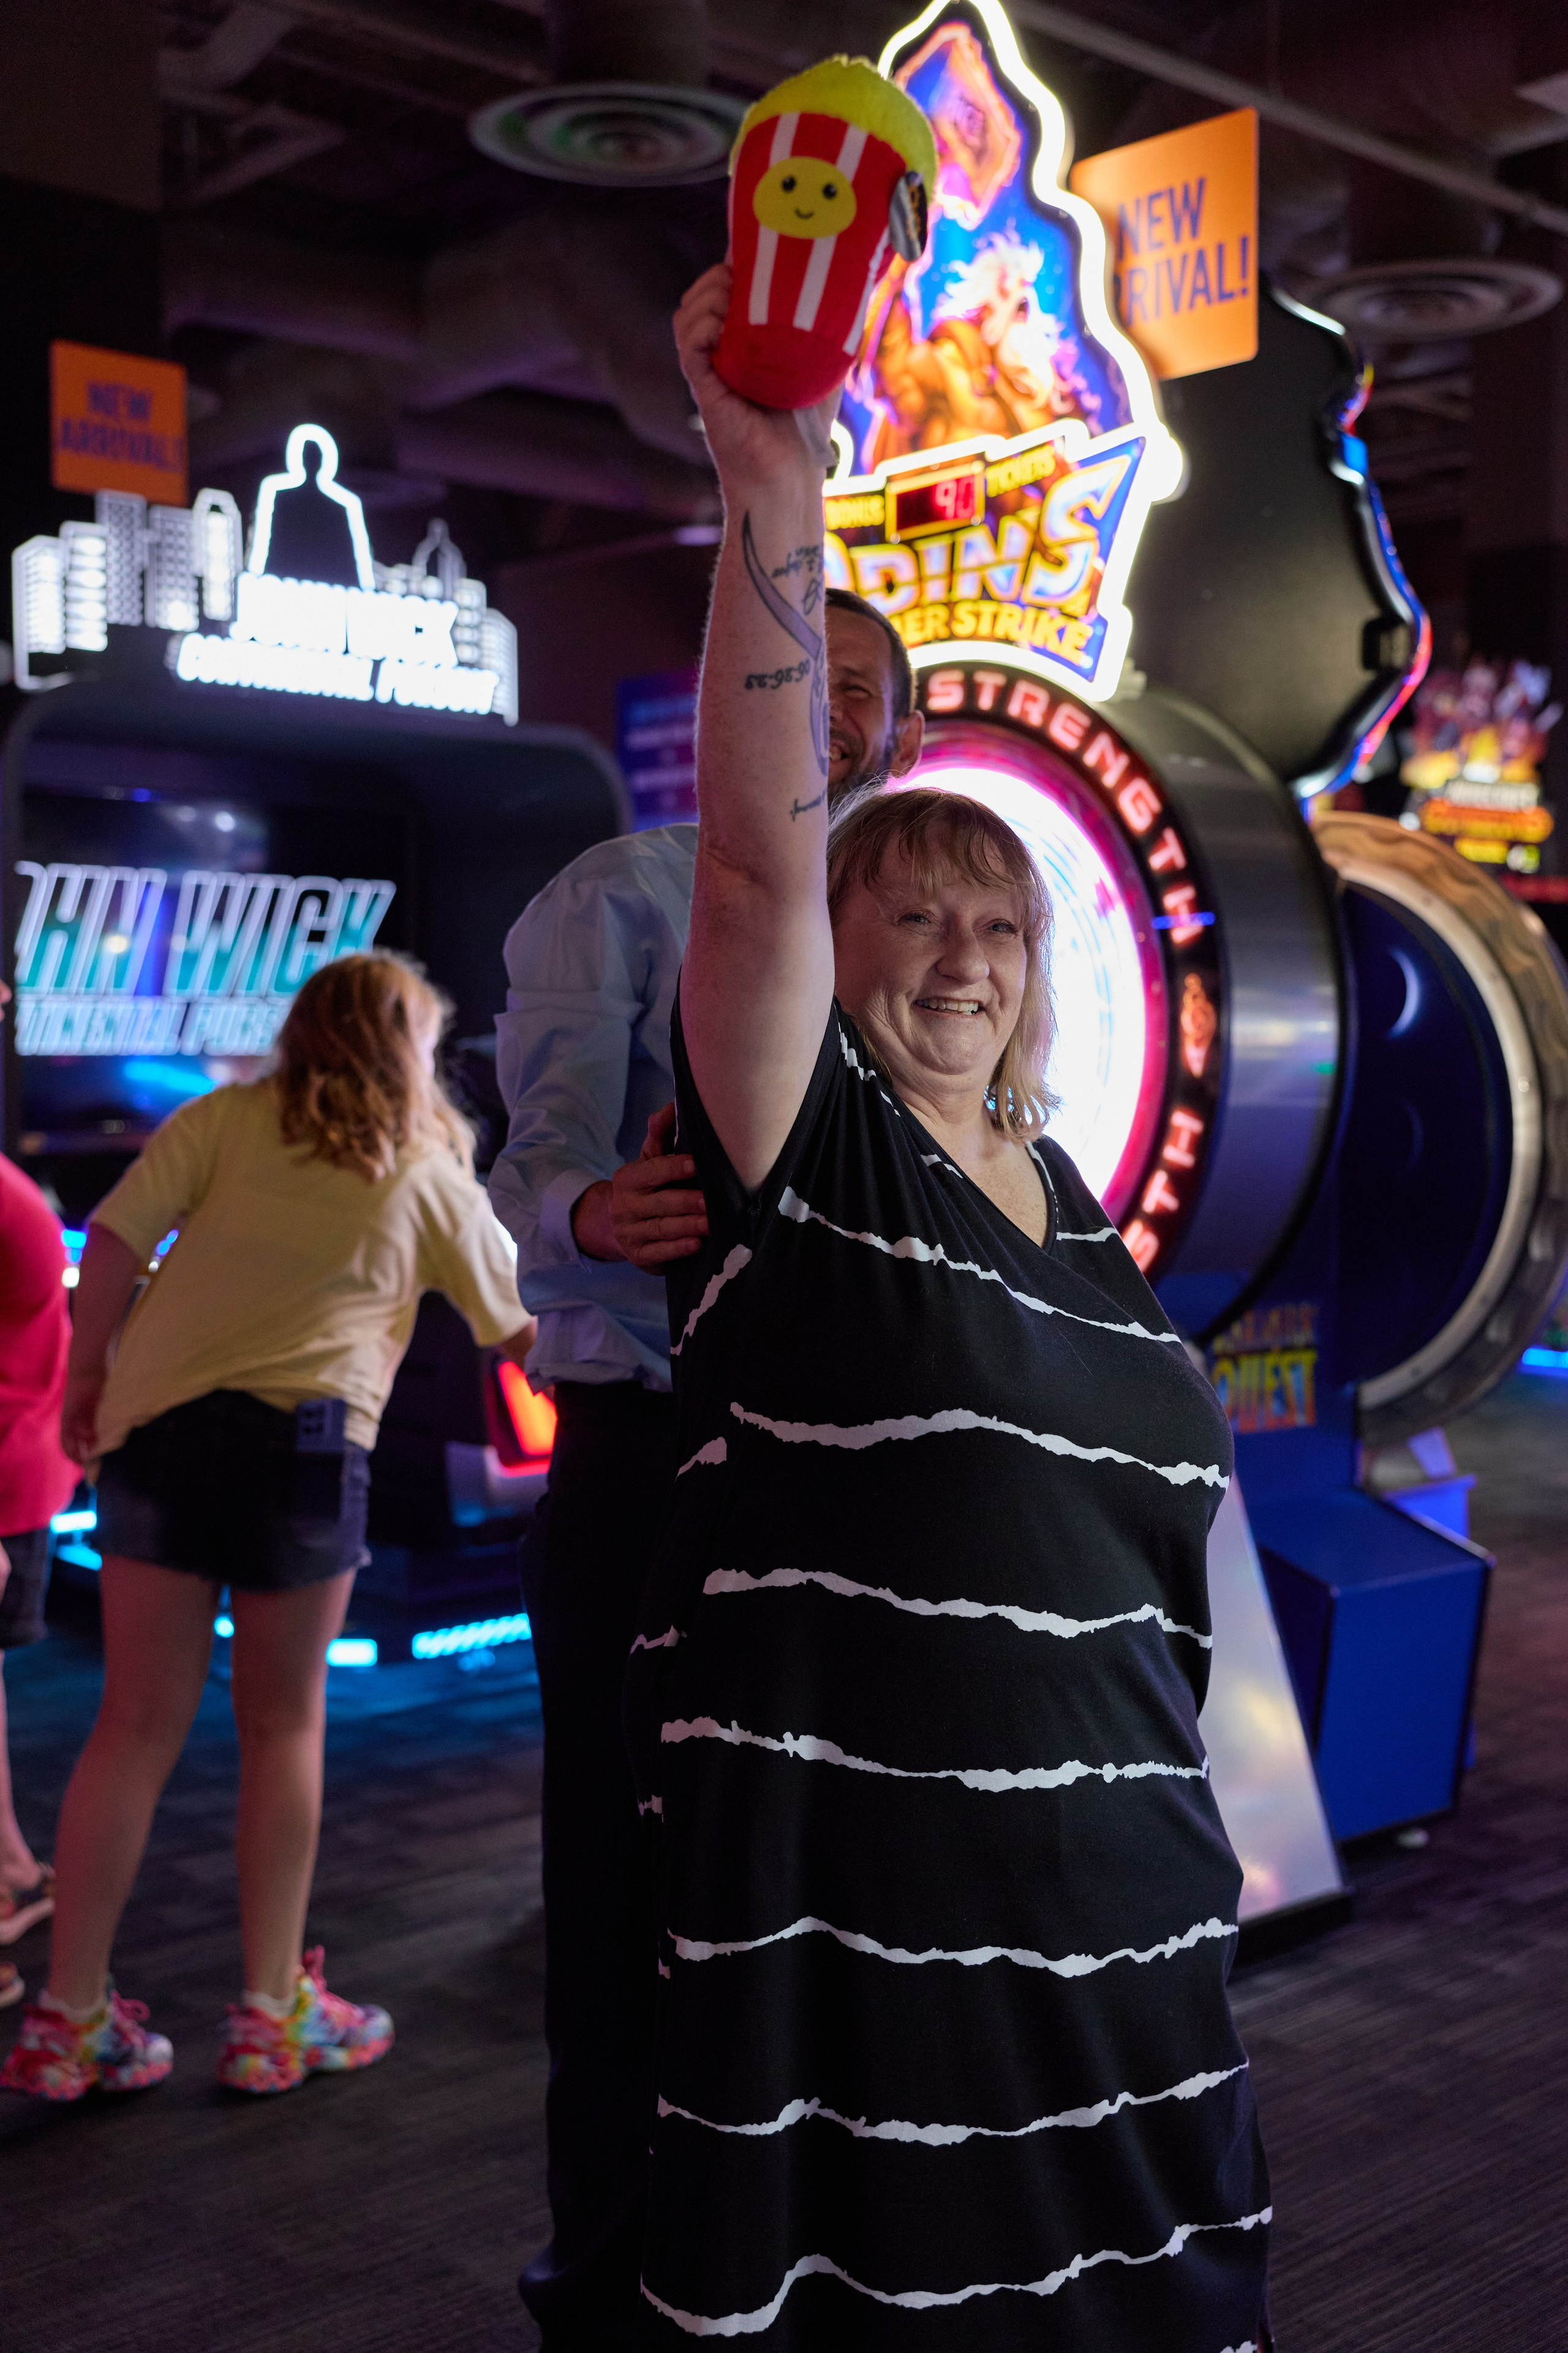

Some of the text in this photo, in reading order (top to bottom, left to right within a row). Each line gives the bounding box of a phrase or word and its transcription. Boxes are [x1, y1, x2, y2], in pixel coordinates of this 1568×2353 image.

[1118, 176, 1206, 260] NEW
[951, 600, 1094, 664] STRIKE
[927, 669, 1204, 945] STRENGTH
[162, 869, 397, 1001] WICK
